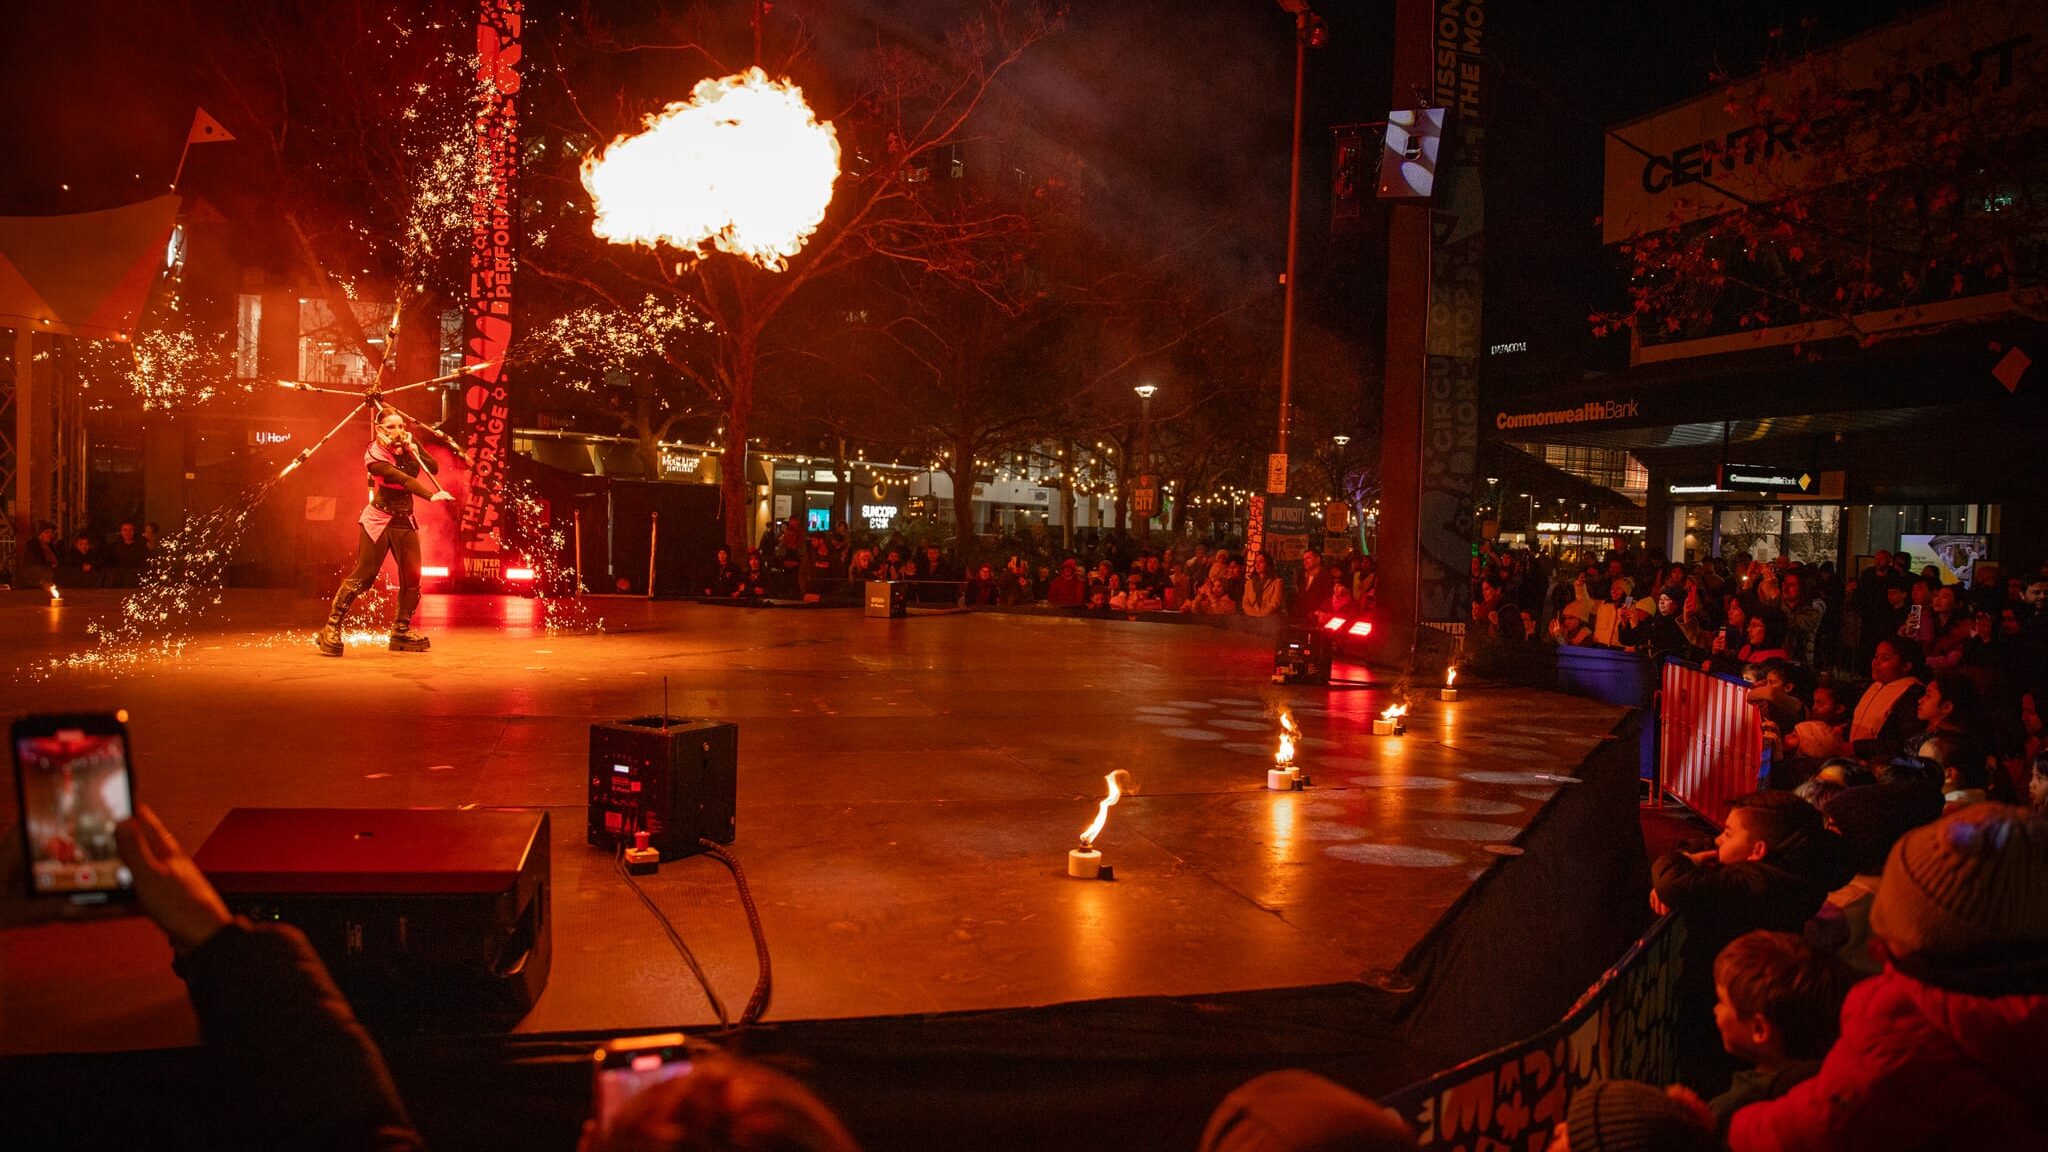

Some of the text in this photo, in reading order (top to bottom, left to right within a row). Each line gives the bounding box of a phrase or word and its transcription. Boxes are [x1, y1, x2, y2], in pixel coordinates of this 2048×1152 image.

[1458, 0, 1485, 120] THE MO
[489, 126, 512, 299] PERFORMANCES
[1430, 336, 1451, 452] CIRCUS
[1496, 399, 1640, 430] CommonwealthBank
[460, 405, 509, 532] THE FORAGE
[862, 505, 897, 518] SUNCORP
[464, 558, 500, 573] WINTER
